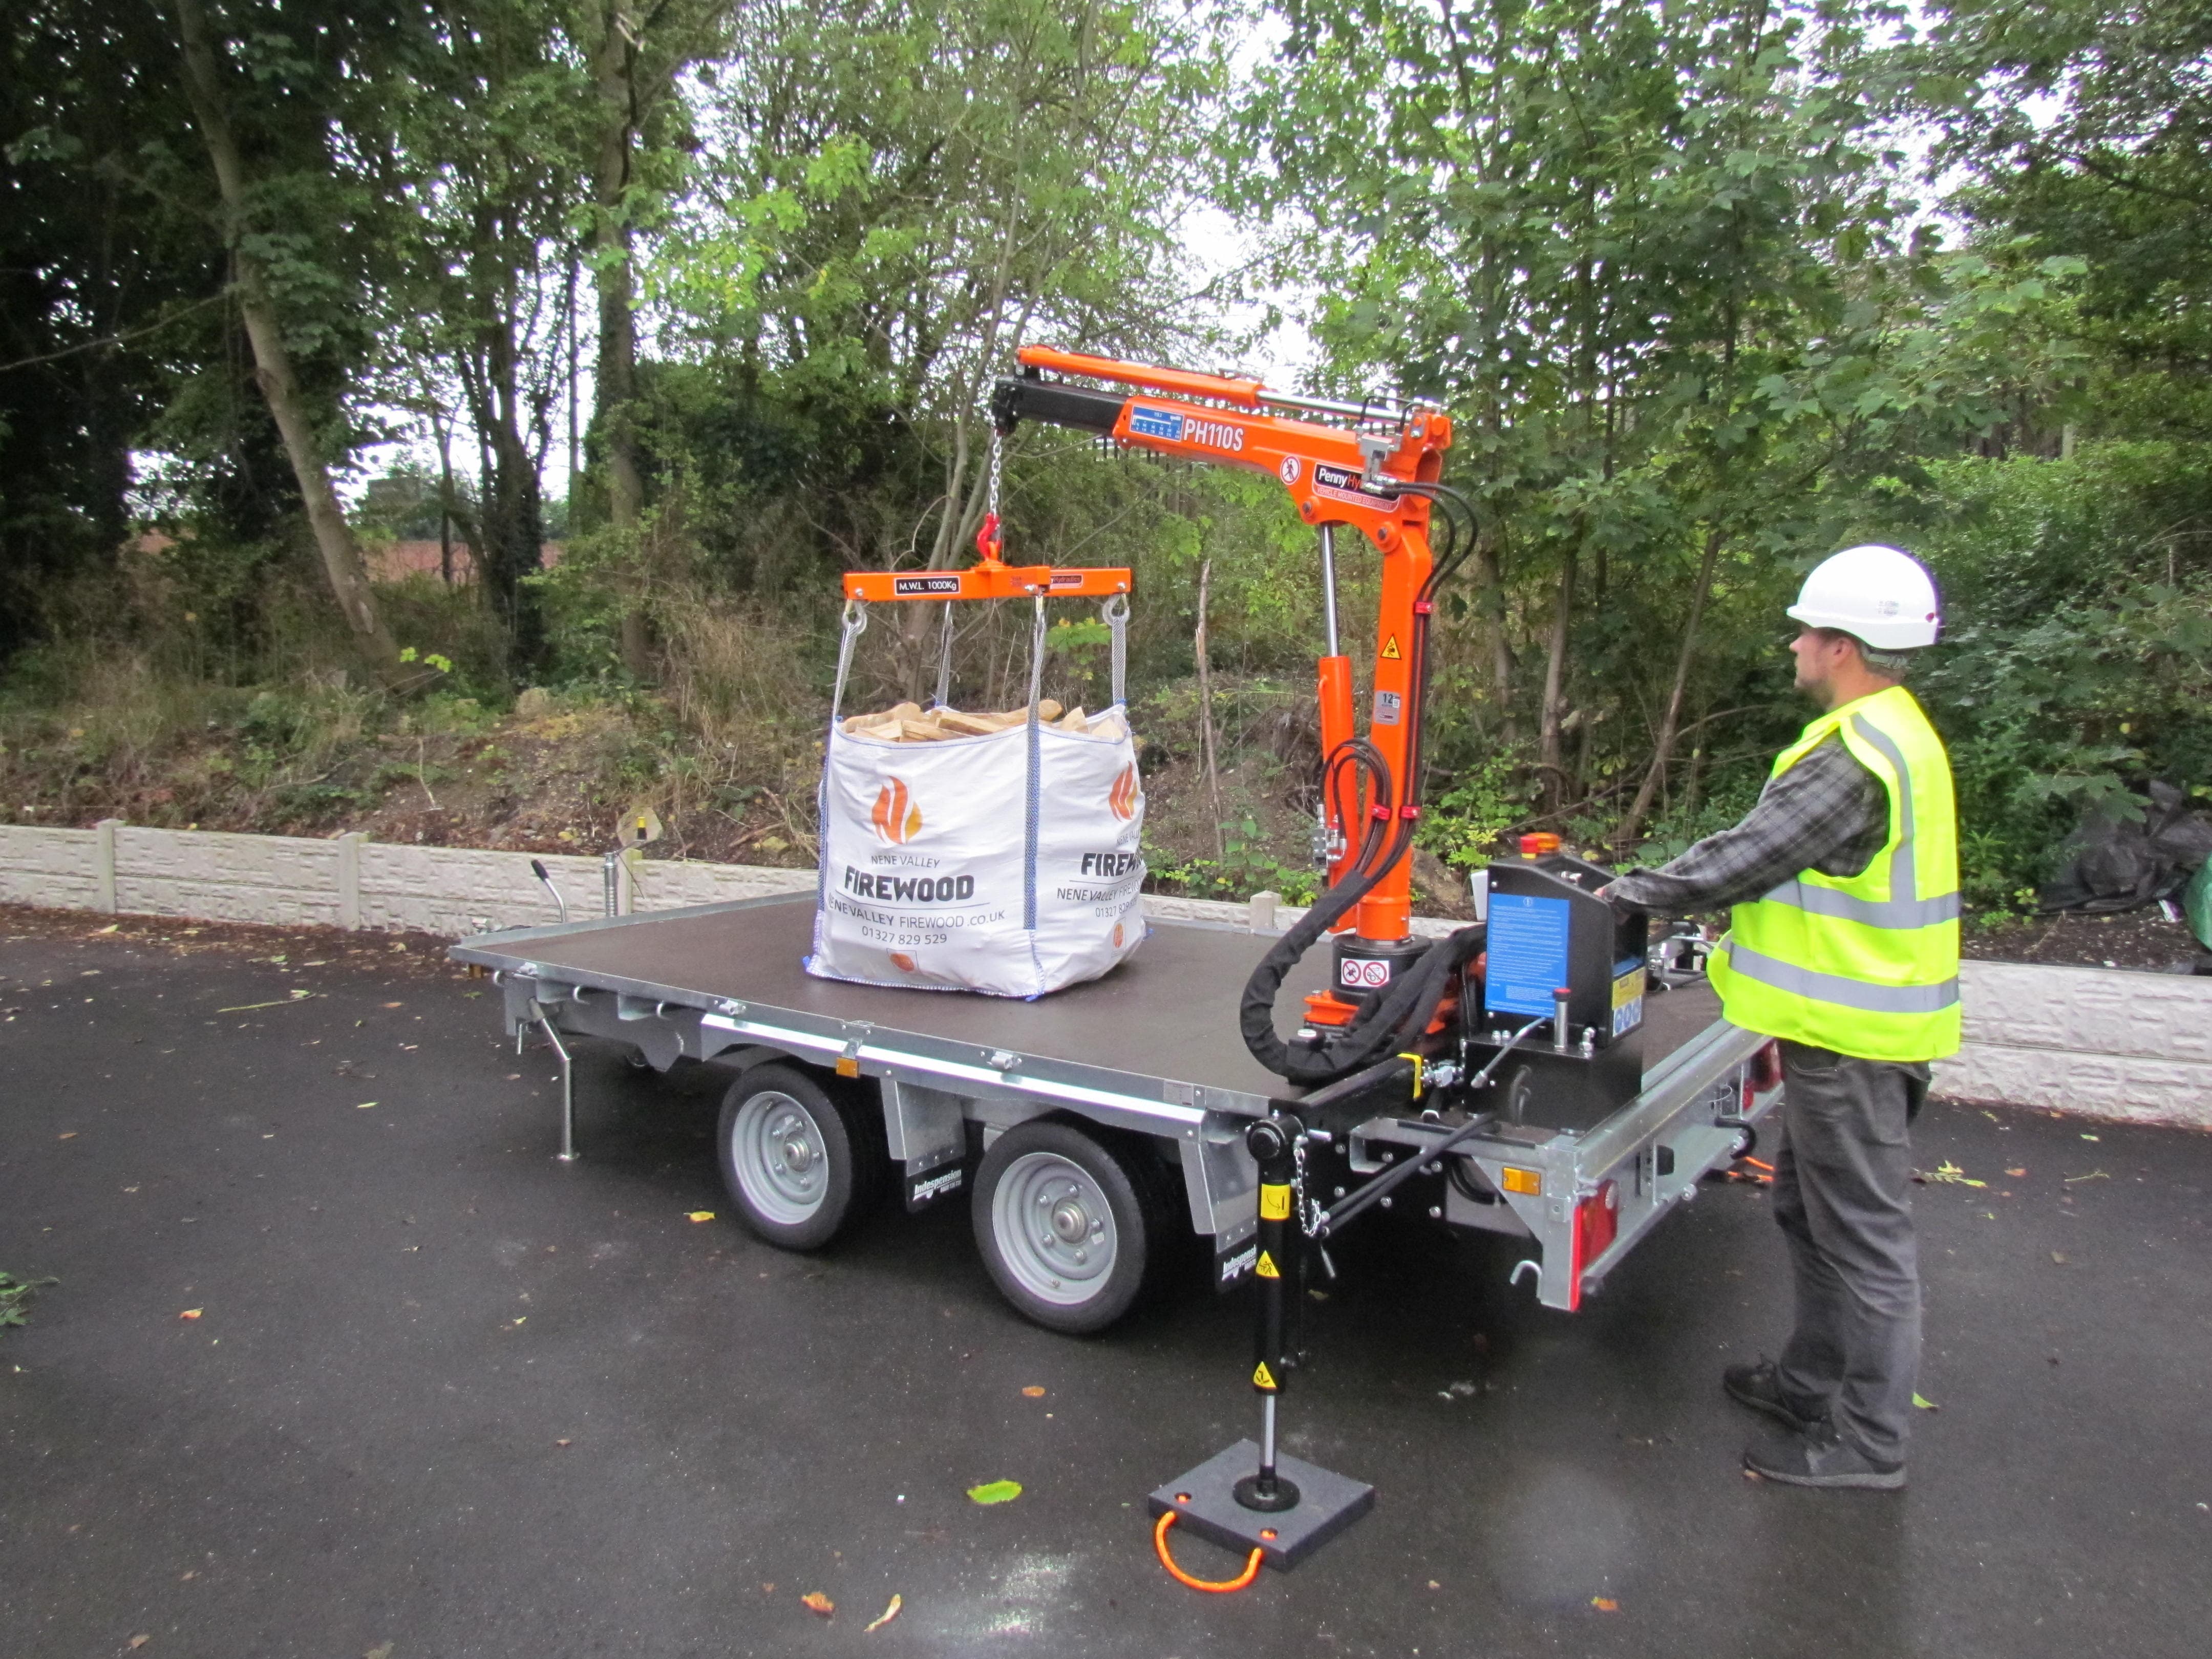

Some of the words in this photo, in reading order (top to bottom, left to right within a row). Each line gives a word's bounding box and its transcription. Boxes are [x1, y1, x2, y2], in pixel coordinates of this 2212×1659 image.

[1183, 418, 1244, 452] PH110S
[1317, 486, 1336, 497] VEHICLE
[1337, 492, 1362, 503] MOUNTED
[1363, 497, 1392, 509] EQUIPMENT
[899, 582, 925, 590] M.W.L.
[928, 581, 956, 591] 1000Kg
[1383, 693, 1393, 704] 12
[1117, 833, 1129, 845] NENE
[871, 856, 897, 865] NENE
[900, 856, 940, 868] VALLEY
[844, 865, 974, 902] FIREWOOD
[1057, 887, 1088, 901] NENE
[1090, 889, 1117, 901] VALLEY
[849, 905, 894, 926] VALLEY
[1095, 906, 1117, 918] 01327
[862, 926, 895, 943] 01327
[898, 934, 921, 945] 829
[924, 933, 947, 944] 529
[914, 1169, 961, 1195] Indespension
